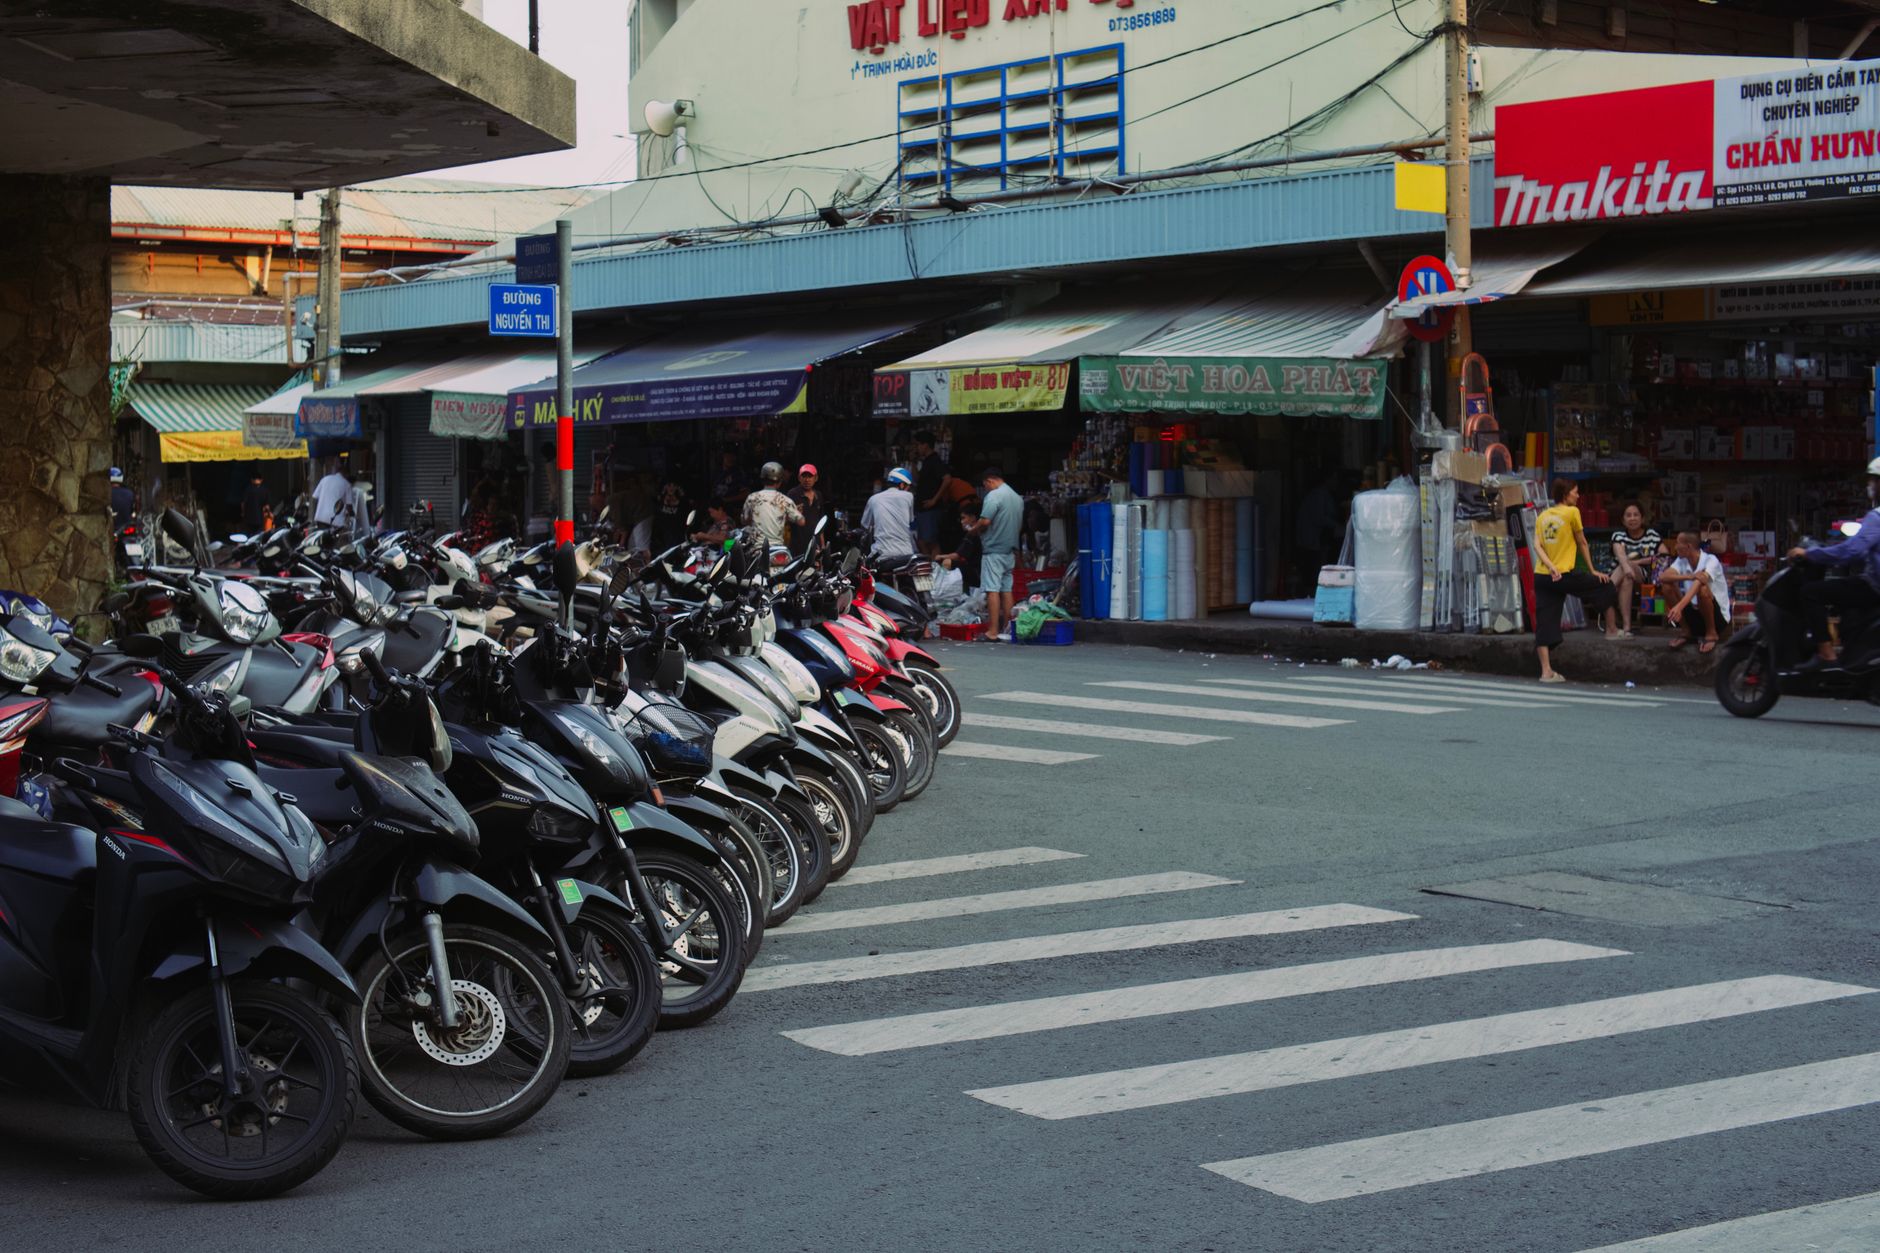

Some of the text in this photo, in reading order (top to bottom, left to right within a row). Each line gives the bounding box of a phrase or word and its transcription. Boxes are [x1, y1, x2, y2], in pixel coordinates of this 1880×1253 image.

[894, 52, 914, 72] HOÀI
[916, 48, 938, 68] ĐỨC
[1740, 82, 1772, 101] DỤNG
[1776, 79, 1792, 97] CỤ
[1860, 68, 1880, 86] TAY
[1763, 94, 1860, 122] CHUYÊN NGHIỆP
[1726, 130, 1880, 170] CHẤN HƯN
[503, 290, 542, 305] ĐƯỜNG
[536, 314, 550, 330] THI
[873, 374, 904, 400] TOP
[1116, 358, 1194, 399] VIỆT
[1202, 365, 1276, 394] HOA
[533, 394, 580, 424] MÀH
[582, 391, 604, 422] KÝ
[848, 656, 875, 672] YAMAHA
[502, 792, 532, 805] HONDA
[374, 820, 404, 835] HONDA
[103, 836, 126, 860] HONDA
